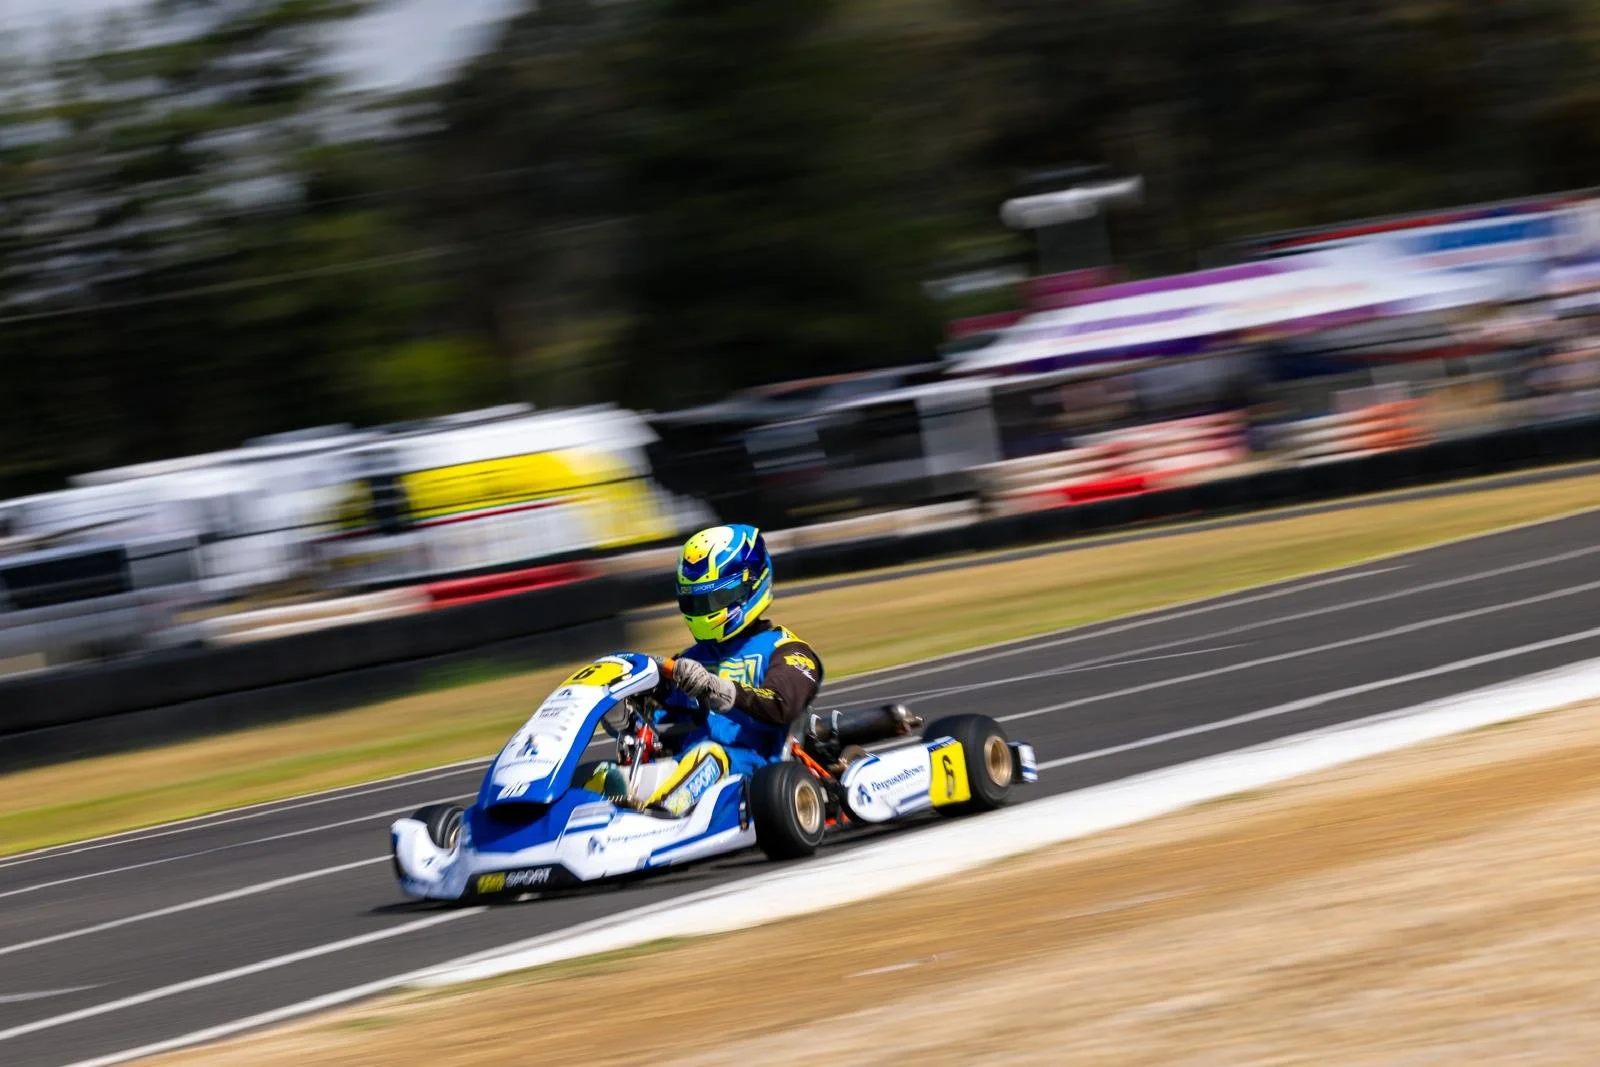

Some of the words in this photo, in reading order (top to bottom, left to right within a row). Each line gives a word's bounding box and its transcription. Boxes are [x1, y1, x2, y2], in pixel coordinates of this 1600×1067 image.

[572, 664, 602, 680] 6
[942, 755, 955, 798] 6
[506, 867, 552, 889] SPORT
